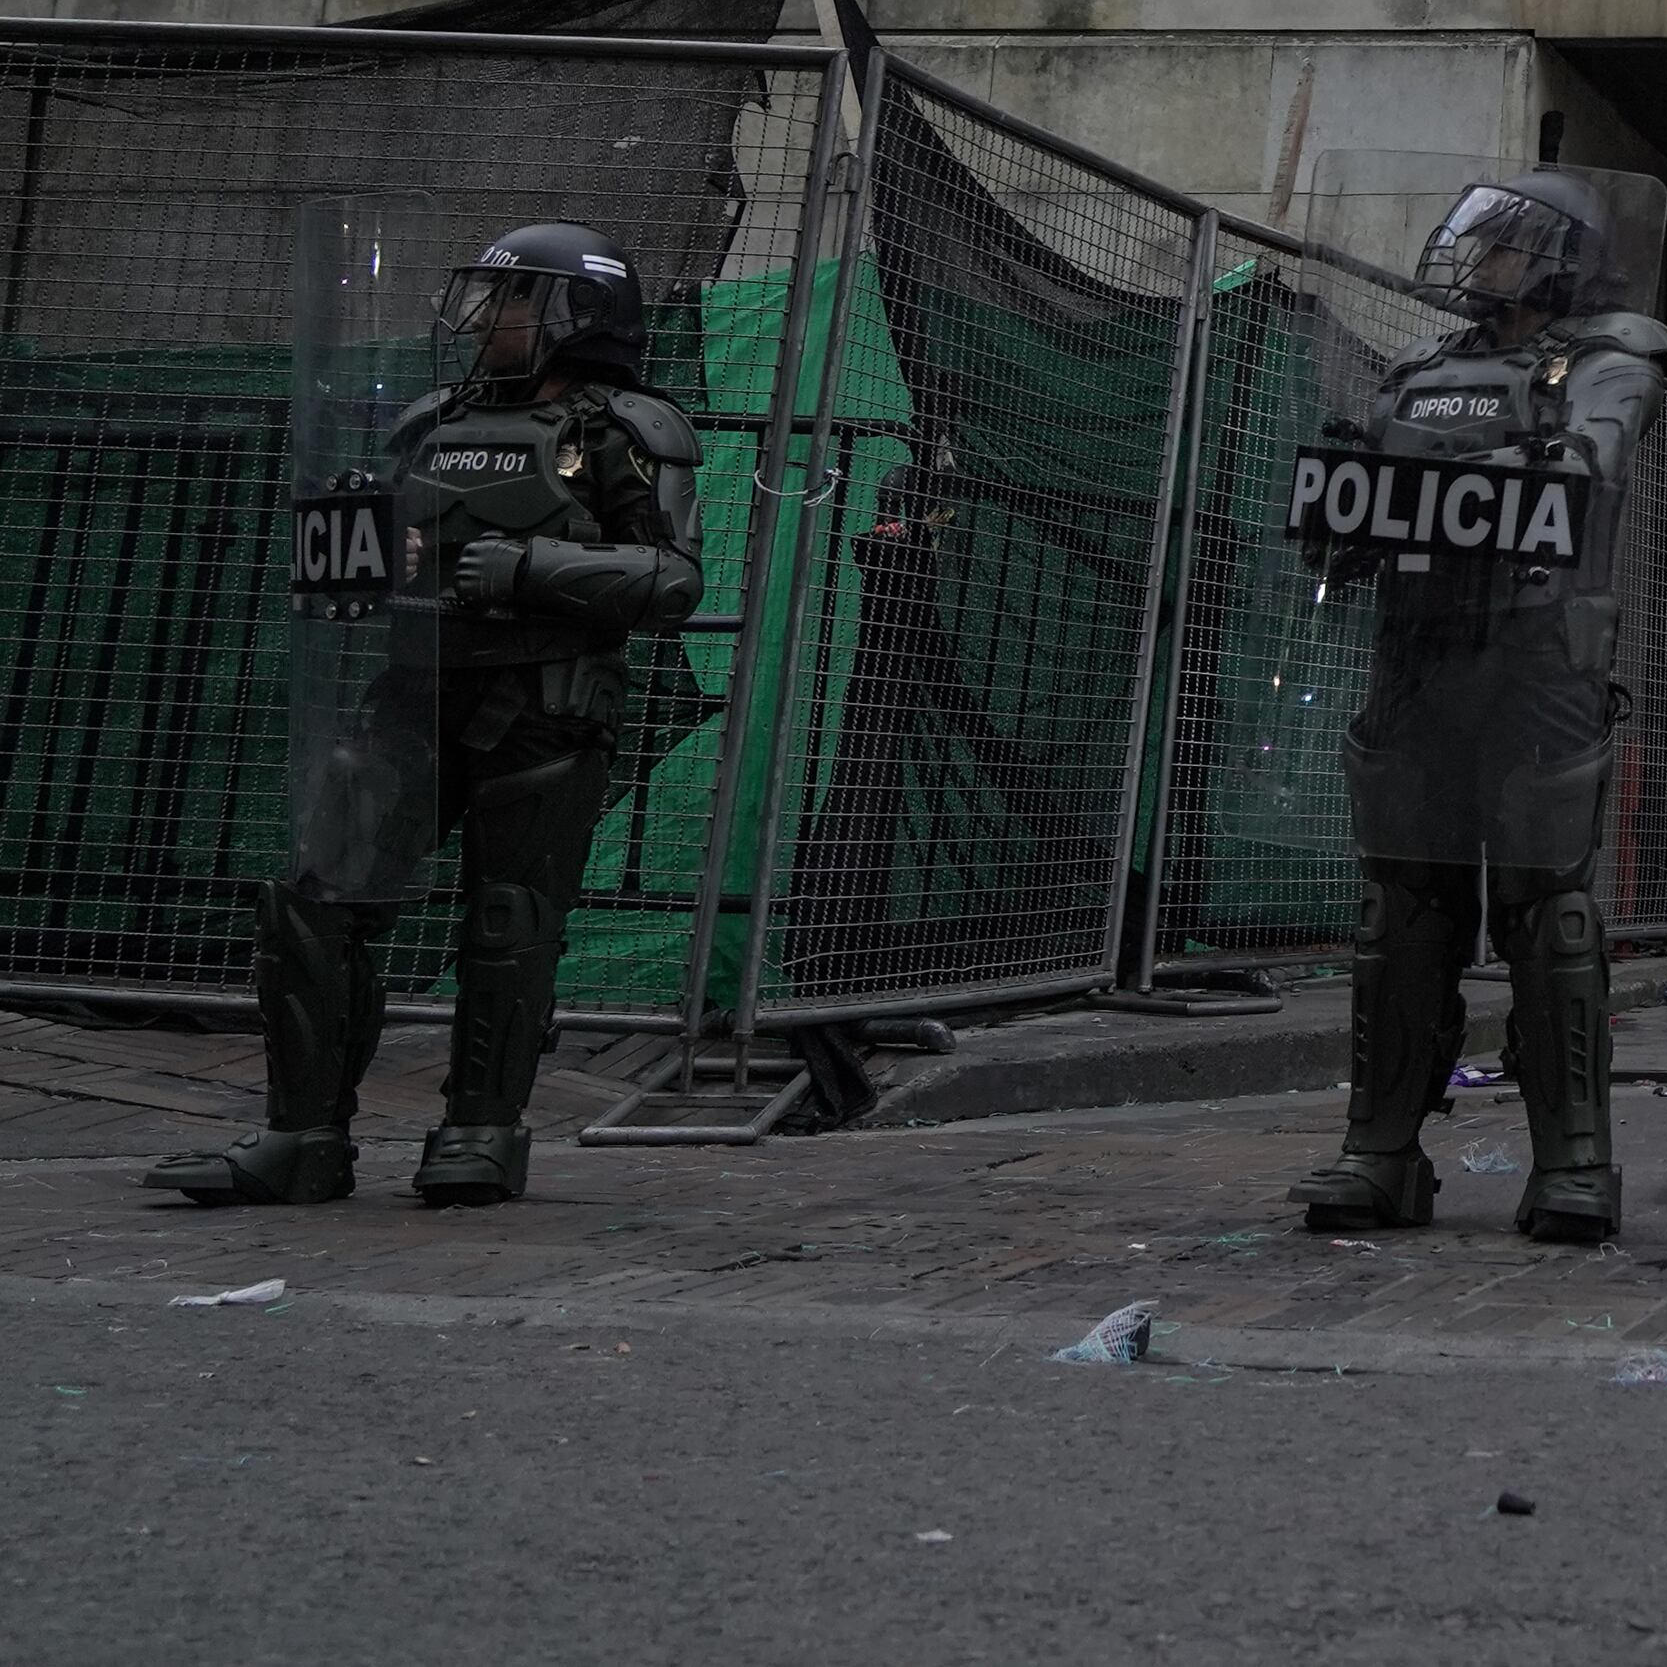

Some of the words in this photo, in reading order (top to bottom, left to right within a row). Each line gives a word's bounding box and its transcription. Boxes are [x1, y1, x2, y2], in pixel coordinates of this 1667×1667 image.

[1410, 396, 1463, 419] DIPRO
[1467, 396, 1500, 417] 102
[429, 450, 489, 472] DIPRO
[493, 451, 528, 473] 101
[1288, 455, 1574, 556] POLICIA
[293, 507, 388, 583] ICIA
